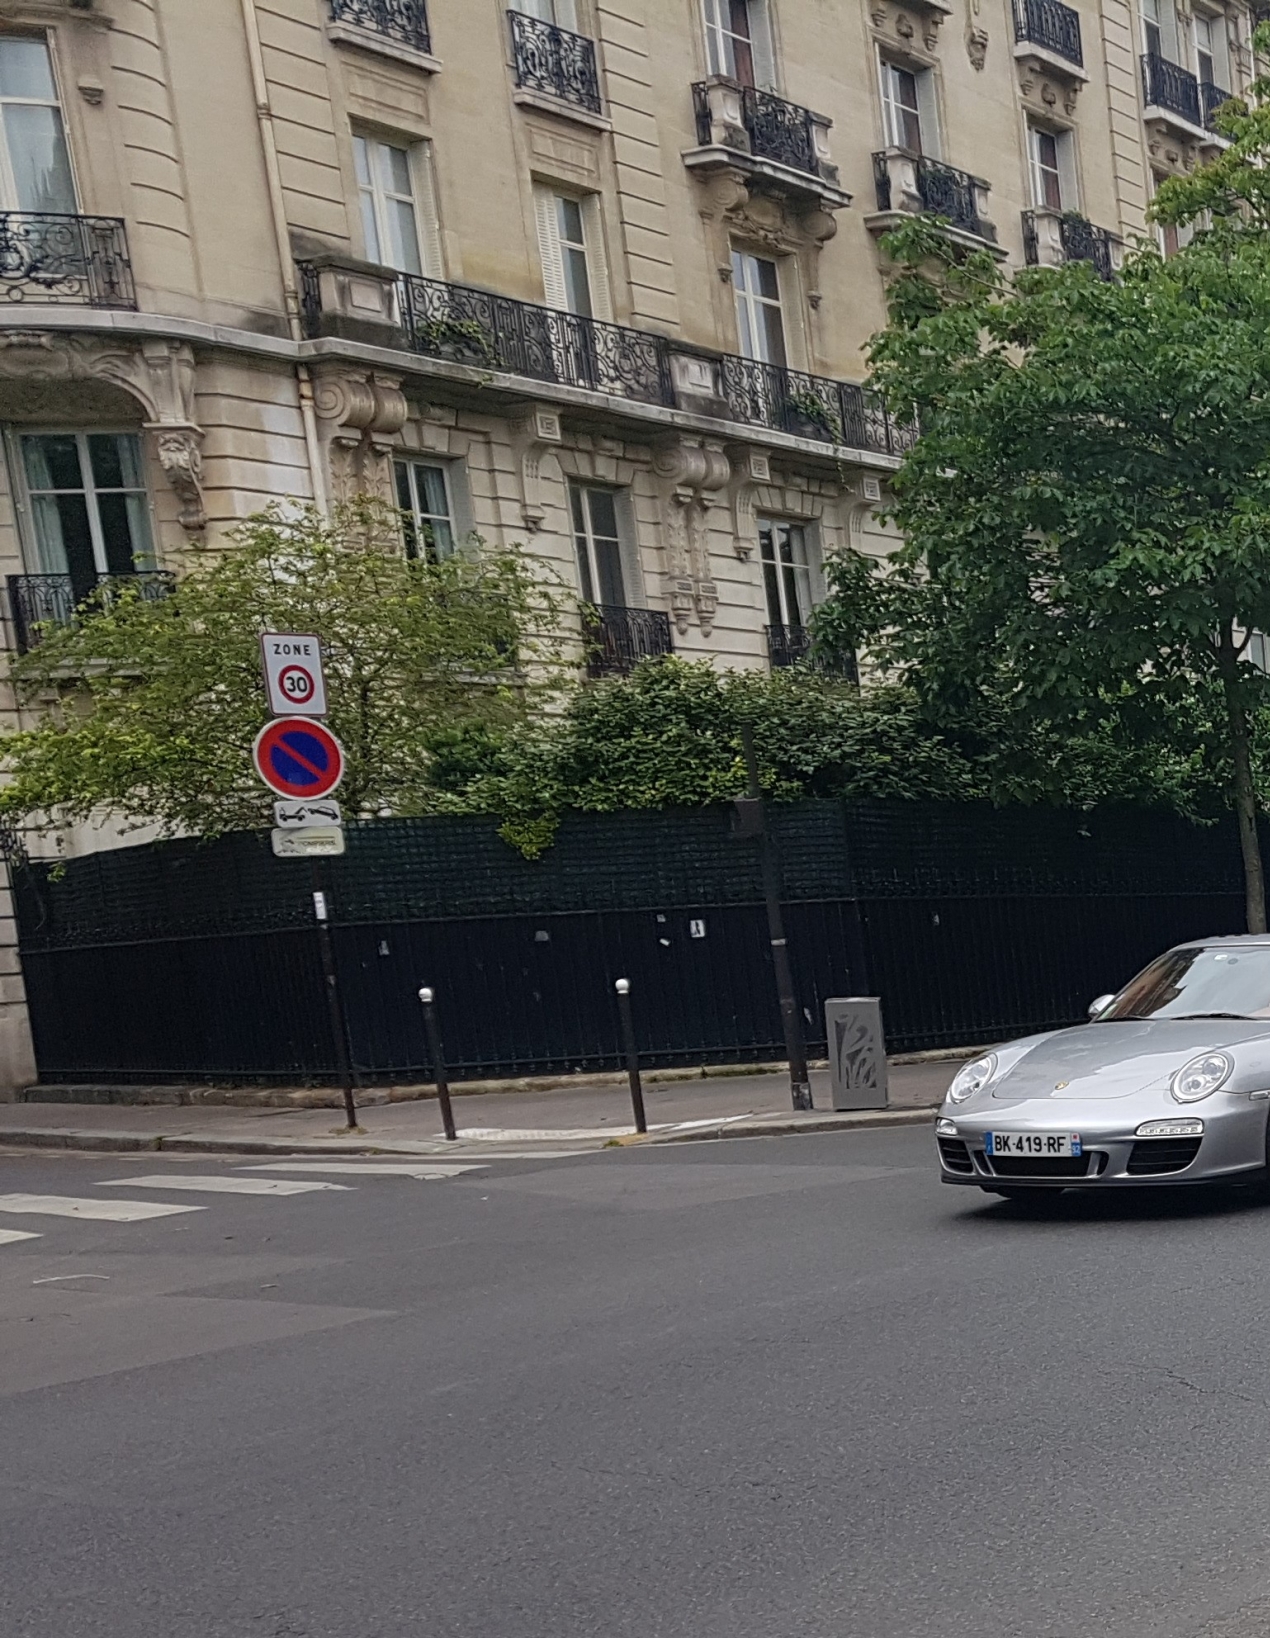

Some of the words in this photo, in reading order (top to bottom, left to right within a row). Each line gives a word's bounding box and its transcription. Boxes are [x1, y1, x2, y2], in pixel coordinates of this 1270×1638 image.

[273, 643, 312, 656] ZONE
[285, 675, 308, 693] 30
[994, 1135, 1067, 1153] BK-419-RF
